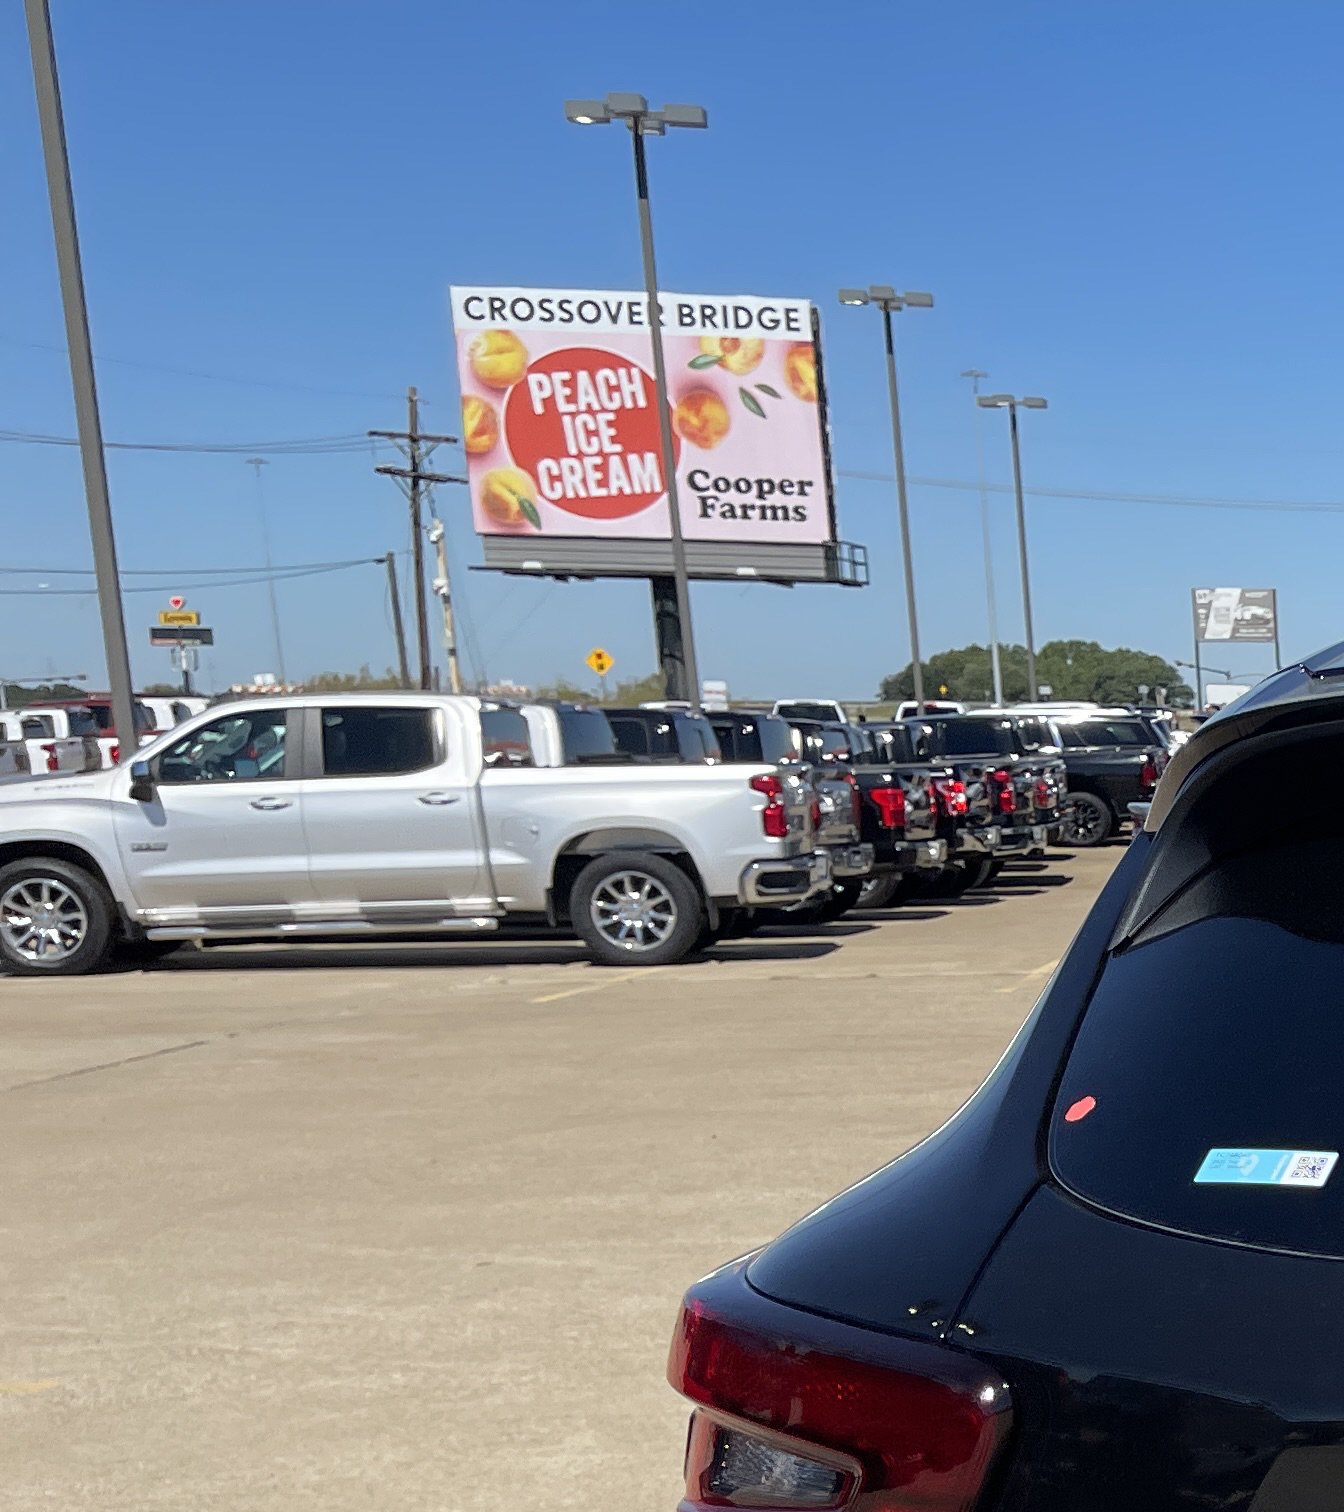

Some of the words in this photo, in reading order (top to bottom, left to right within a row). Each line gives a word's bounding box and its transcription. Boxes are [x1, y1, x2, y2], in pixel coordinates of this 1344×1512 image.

[677, 303, 801, 332] BRIDGE
[527, 367, 648, 416] PEACH
[562, 412, 622, 456] ICE
[536, 452, 663, 501] CREAM
[687, 470, 814, 501] Cooper
[698, 496, 808, 522] Farms
